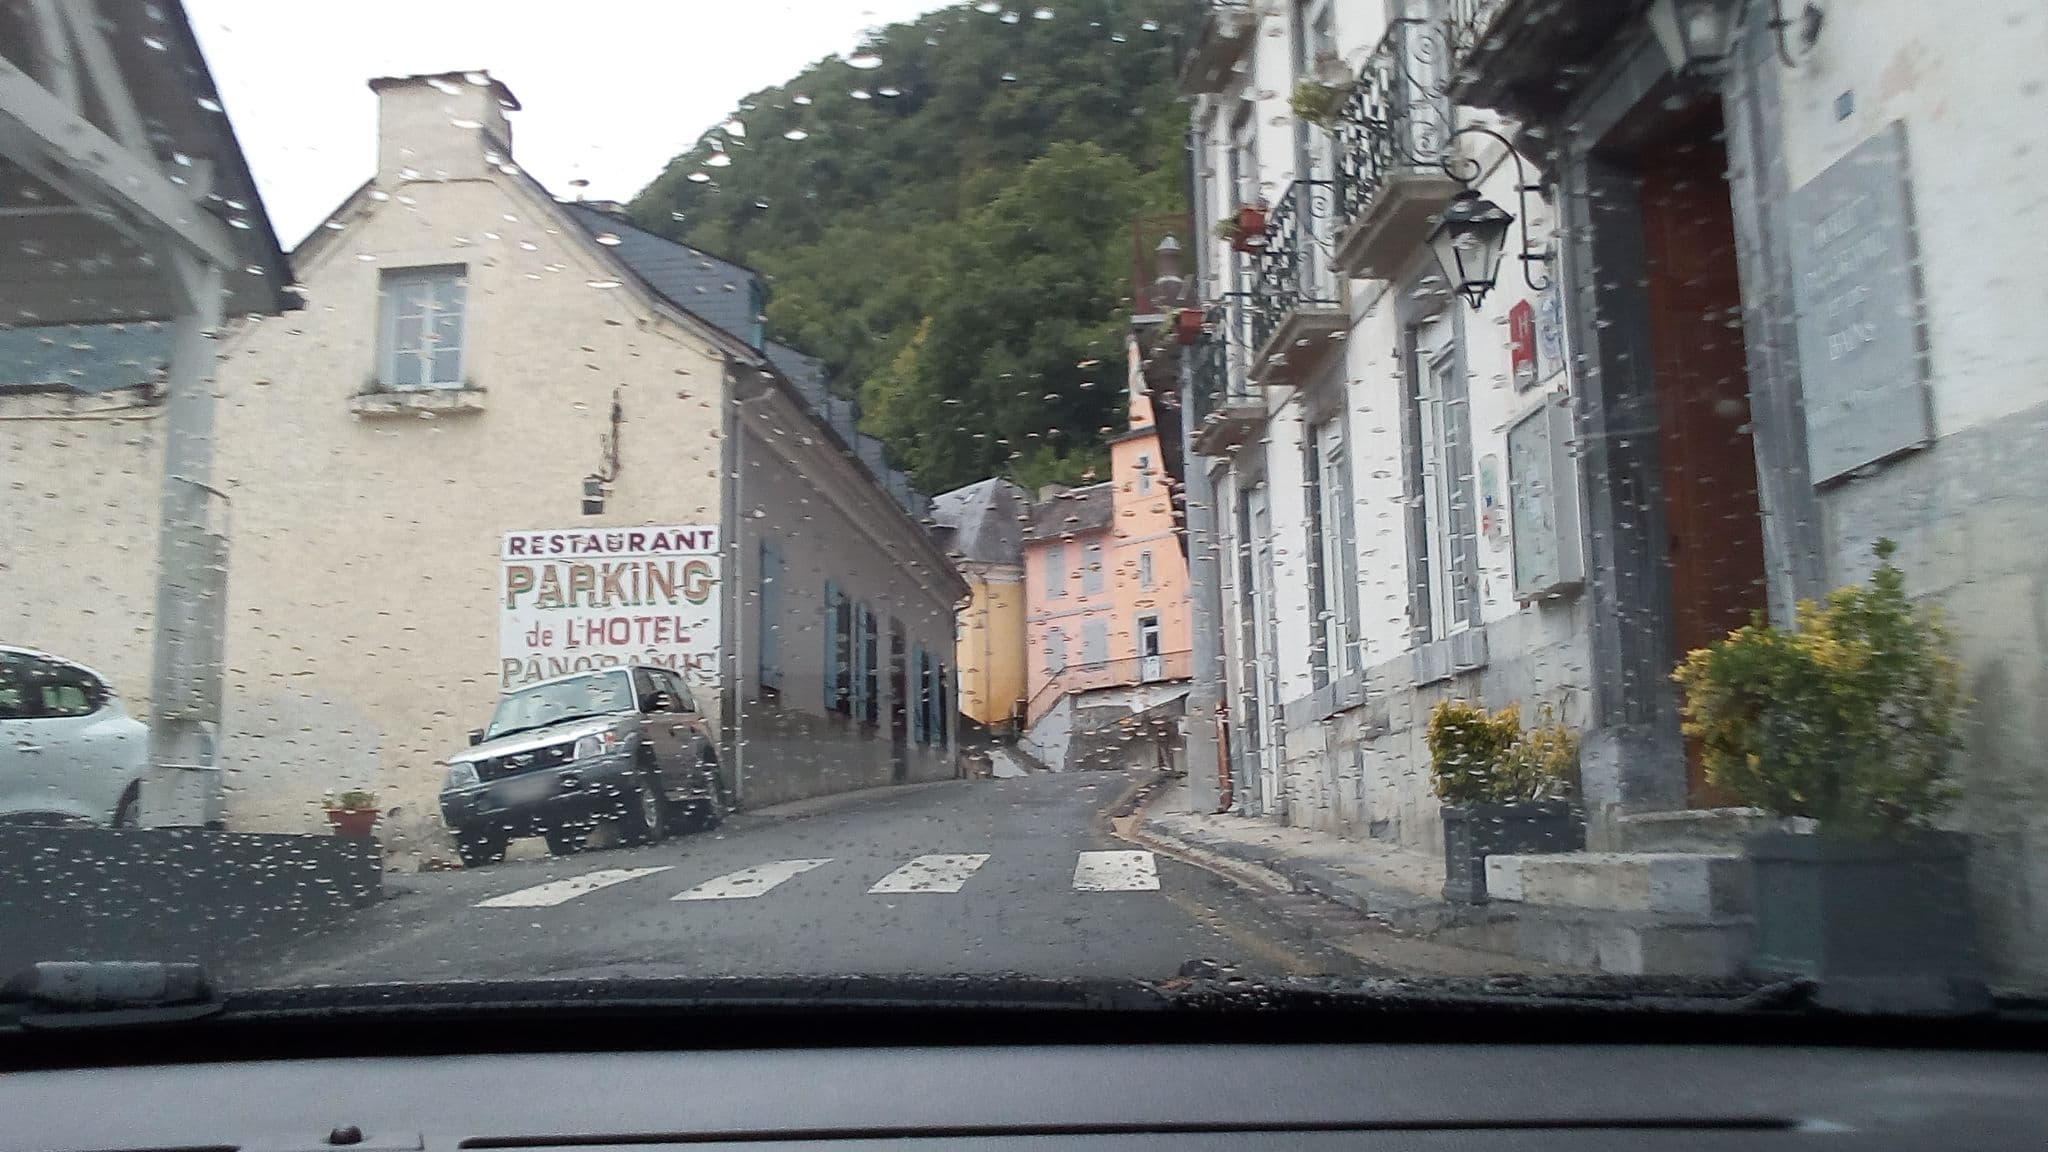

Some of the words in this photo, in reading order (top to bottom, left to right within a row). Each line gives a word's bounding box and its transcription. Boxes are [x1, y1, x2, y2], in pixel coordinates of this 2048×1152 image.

[509, 531, 713, 555] RESTAURANT
[505, 560, 712, 609] PARKING
[526, 620, 554, 647] de
